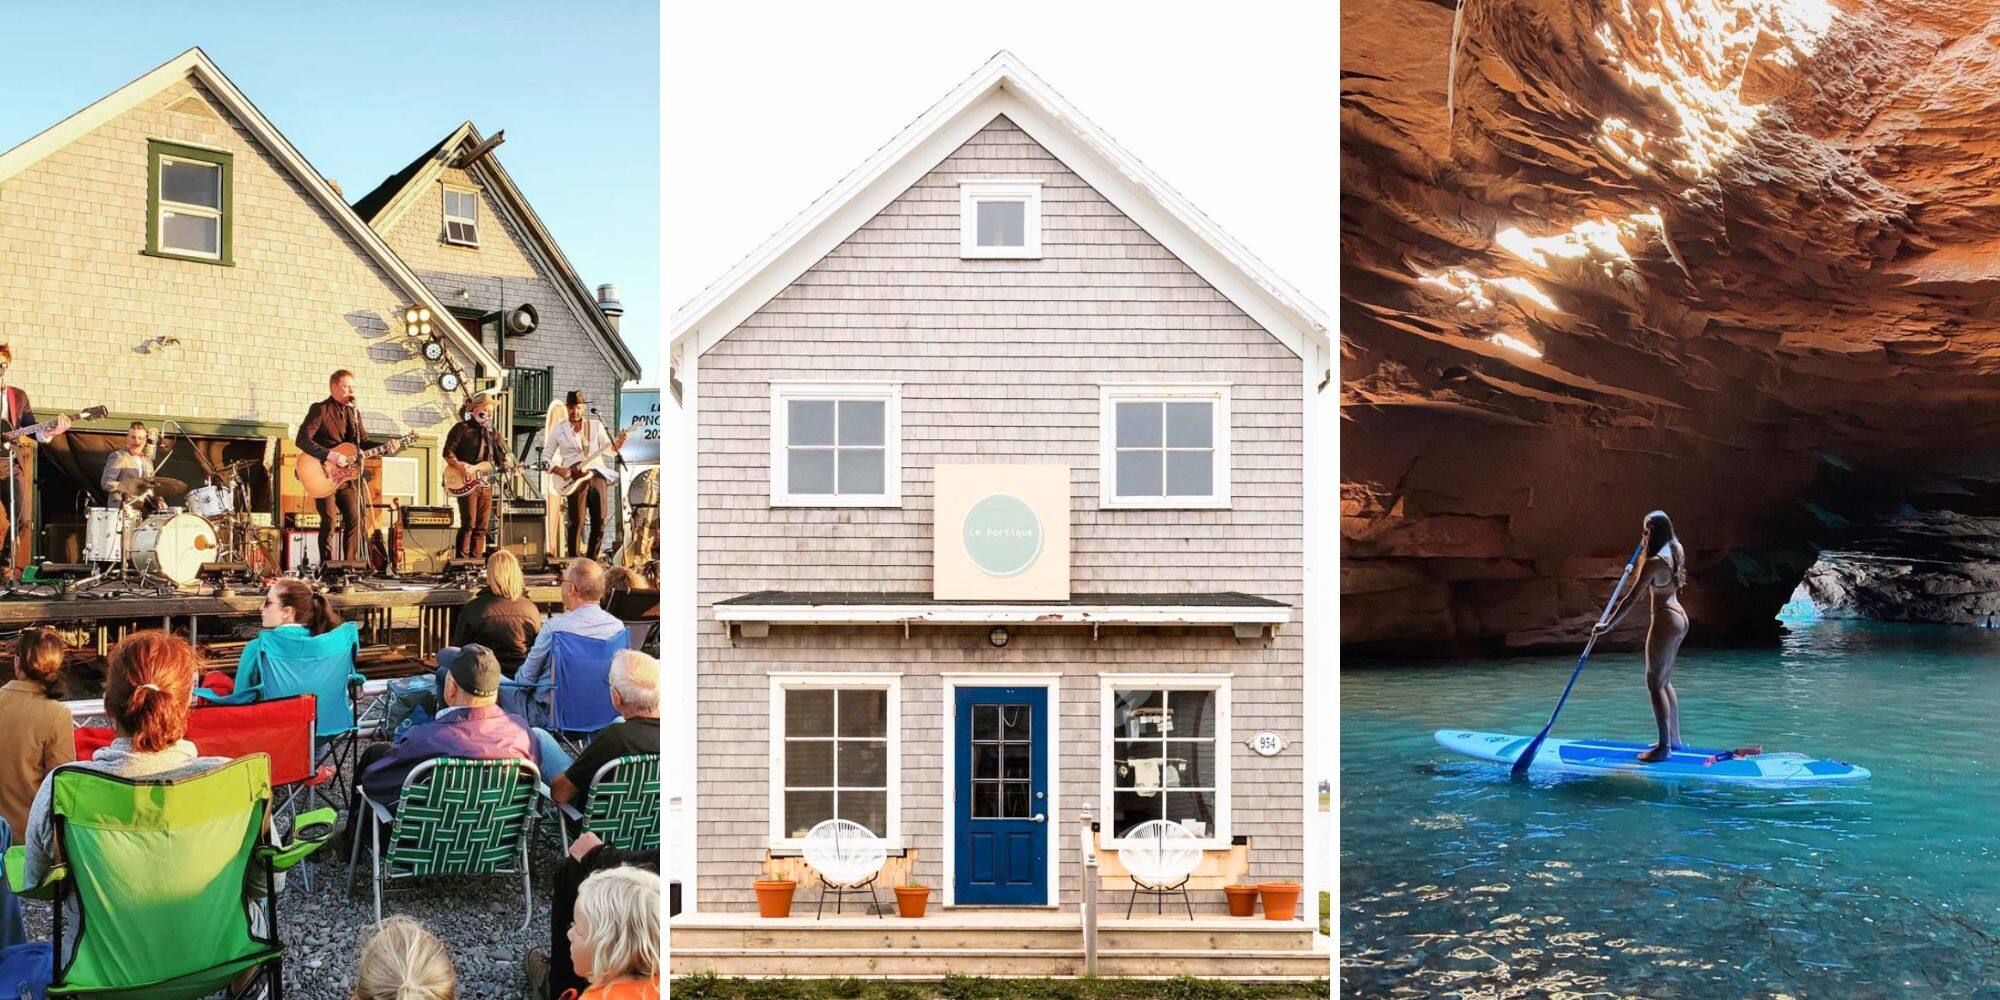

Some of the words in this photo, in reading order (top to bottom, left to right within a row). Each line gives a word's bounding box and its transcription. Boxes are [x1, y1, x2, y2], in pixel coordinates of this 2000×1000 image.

[969, 528, 982, 537] Le
[986, 528, 1033, 538] Portique
[1260, 737, 1276, 749] 954
